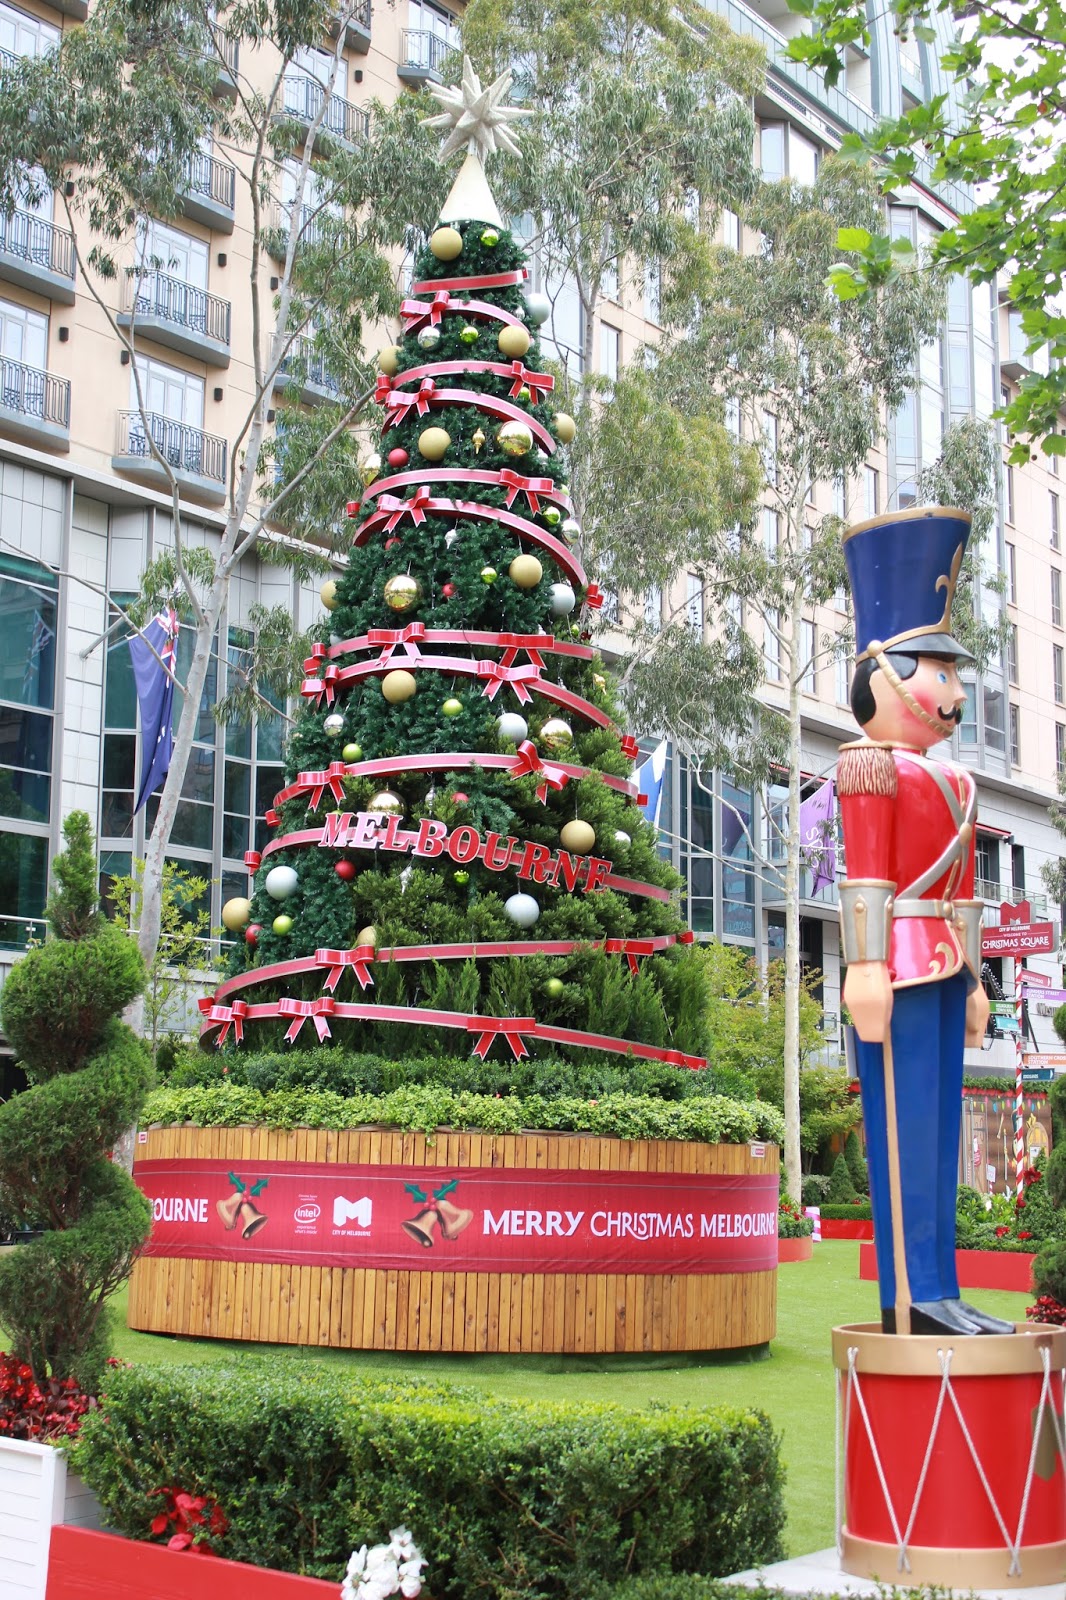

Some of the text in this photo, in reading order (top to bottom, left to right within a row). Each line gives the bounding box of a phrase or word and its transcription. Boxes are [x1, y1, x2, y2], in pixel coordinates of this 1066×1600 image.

[318, 811, 613, 894] MELBOURNE
[982, 936, 1050, 949] CHRISTMAS SQUARE
[296, 1207, 317, 1218] intel
[482, 1209, 775, 1240] MERRY CHRISTMAS MELBOURNE
[347, 1229, 372, 1237] MELBOURNE
